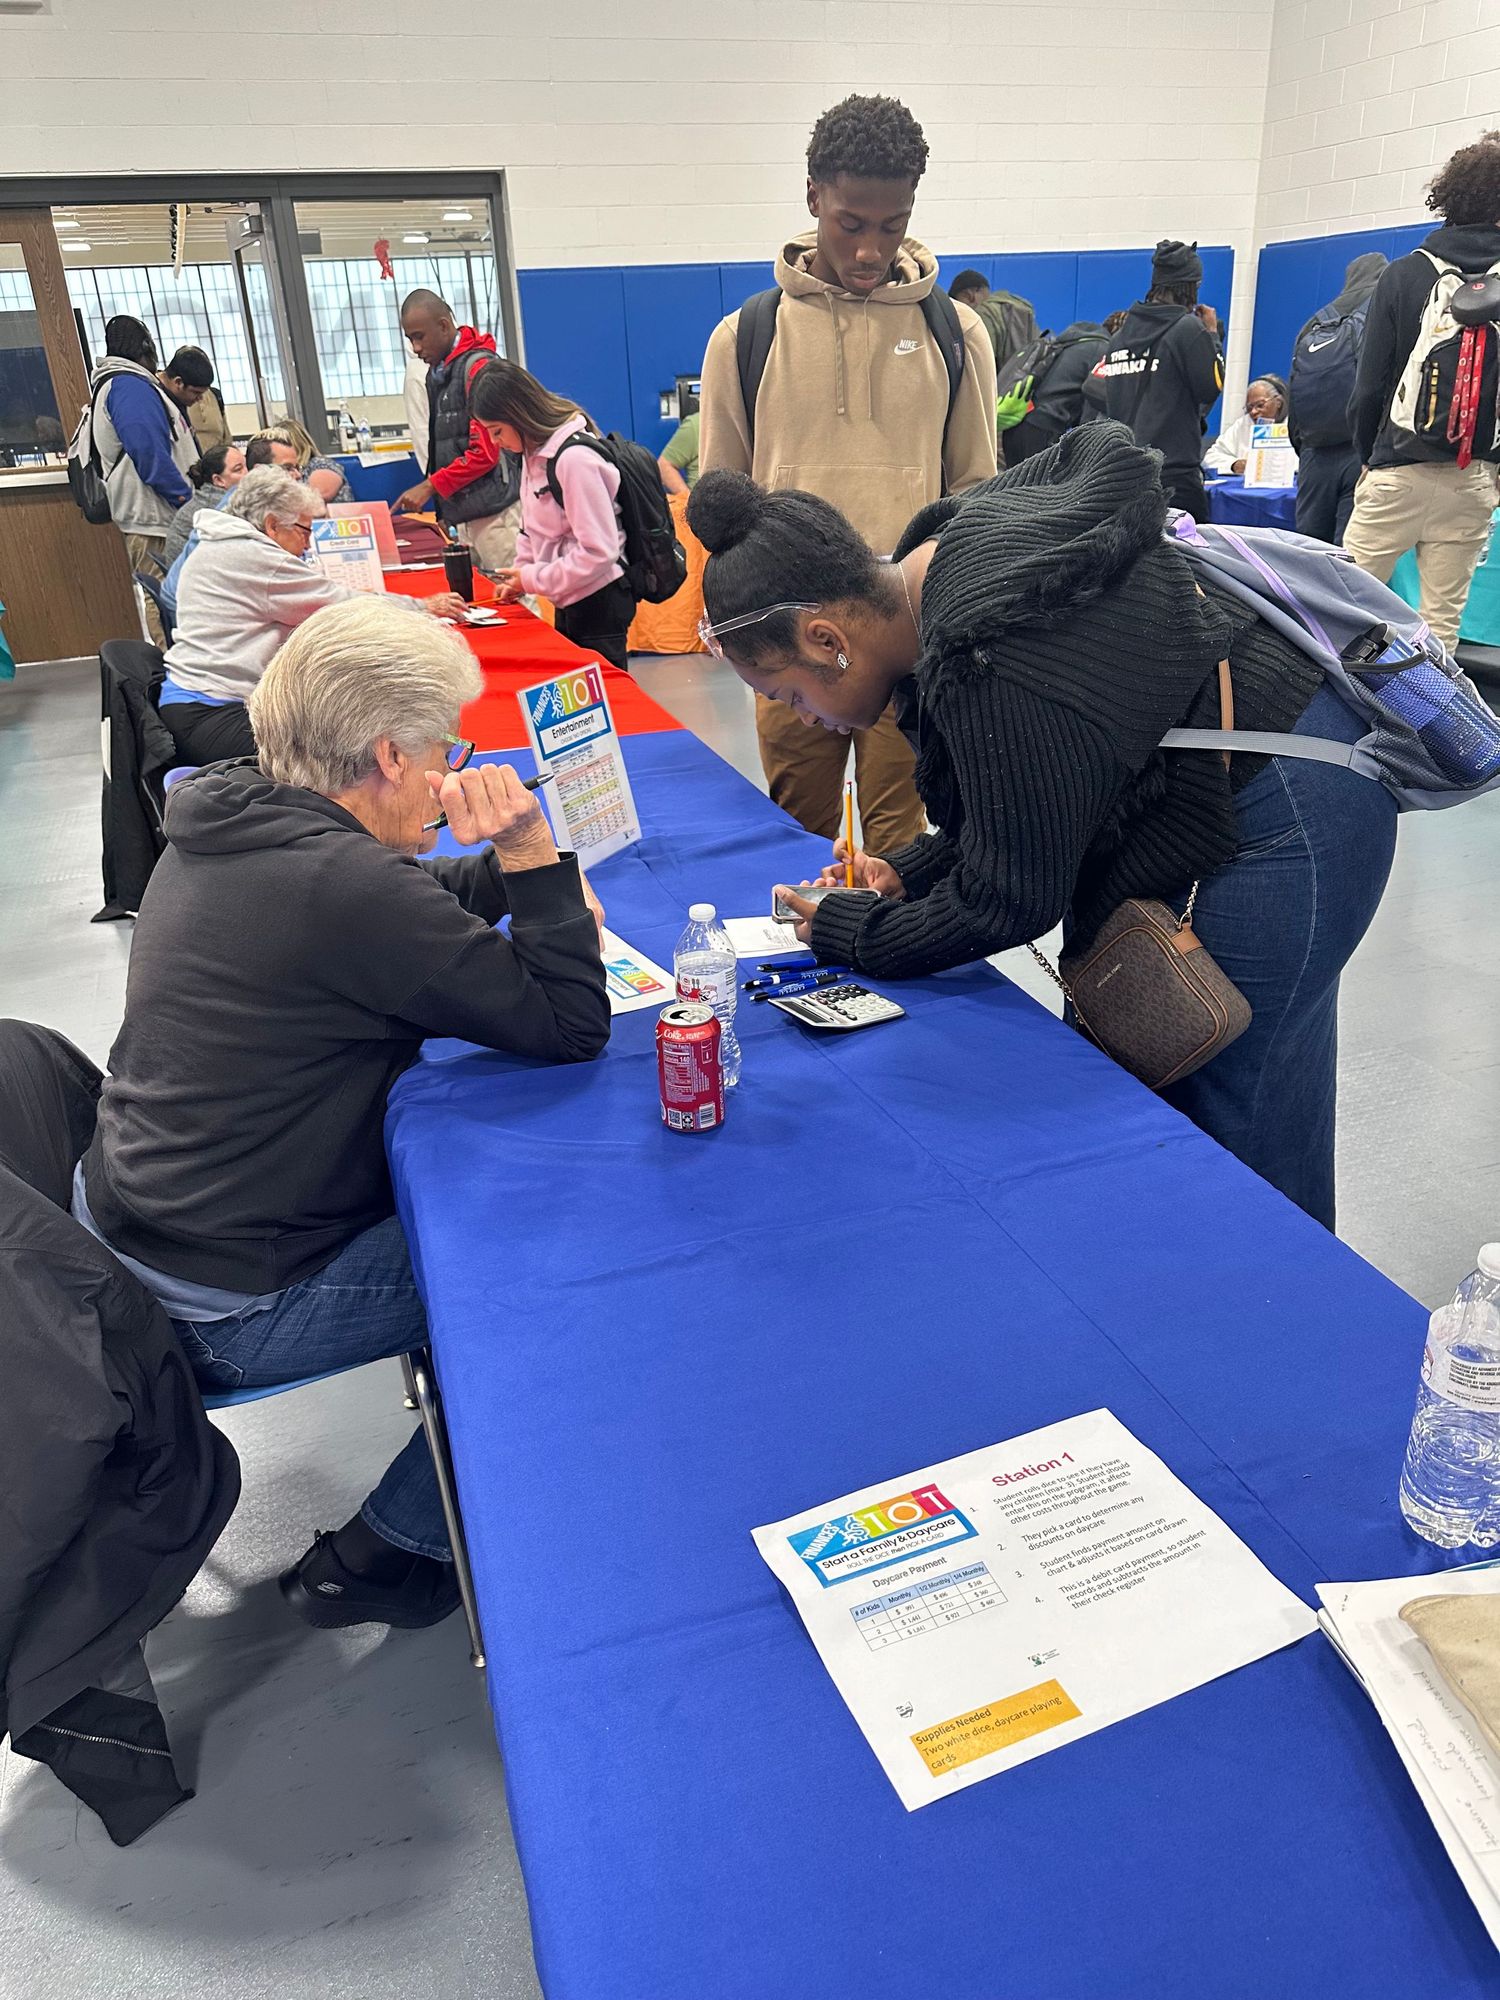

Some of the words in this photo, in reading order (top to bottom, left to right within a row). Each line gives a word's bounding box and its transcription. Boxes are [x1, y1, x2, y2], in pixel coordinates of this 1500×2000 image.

[899, 339, 918, 350] NIKE
[339, 520, 369, 536] 101
[532, 685, 551, 727] FINANCES
[551, 713, 594, 739] Entertainment
[664, 1029, 681, 1039] Coke
[992, 1459, 1062, 1486] Station
[1062, 1452, 1075, 1463] 1
[993, 1491, 1024, 1505] Student
[1024, 1486, 1040, 1494] rolls
[1041, 1480, 1056, 1488] dice
[1067, 1472, 1080, 1480] see
[1086, 1464, 1103, 1474] they
[1102, 1458, 1120, 1468] have
[1000, 1502, 1014, 1511] any
[1015, 1491, 1045, 1506] children
[1077, 1471, 1105, 1485] Student
[1106, 1462, 1130, 1474] should
[1005, 1507, 1025, 1518] enter
[1026, 1501, 1040, 1510] this
[1052, 1492, 1066, 1501] the
[1066, 1482, 1100, 1497] program,
[1107, 1471, 1131, 1482] affects
[1010, 1513, 1031, 1525] other
[1032, 1506, 1052, 1517] costs
[1051, 1491, 1094, 1511] throughout
[1094, 1487, 1107, 1496] the
[801, 1522, 839, 1560] FINANCES
[997, 1543, 1007, 1551] 2.
[1021, 1532, 1042, 1543] They
[1042, 1526, 1058, 1536] pick
[1065, 1517, 1082, 1527] card
[1092, 1500, 1130, 1517] determine
[1131, 1496, 1144, 1504] any
[1028, 1534, 1064, 1551] discounts
[1065, 1530, 1076, 1538] on
[1076, 1519, 1106, 1534] daycare
[822, 1551, 849, 1569] Start
[850, 1550, 859, 1559] a
[859, 1537, 898, 1557] Family
[898, 1534, 907, 1542] &
[907, 1518, 955, 1540] Daycare
[847, 1560, 863, 1569] ROLL
[875, 1550, 890, 1559] DICE
[890, 1545, 906, 1555] then
[906, 1540, 920, 1549] PICK
[926, 1532, 944, 1542] CARD
[1015, 1570, 1024, 1578] 3.
[1040, 1553, 1072, 1569] Student
[1072, 1546, 1091, 1557] finds
[1092, 1533, 1125, 1550] payment
[1126, 1522, 1155, 1537] amount
[1047, 1565, 1068, 1576] chart
[1076, 1551, 1105, 1566] adjusts
[1110, 1539, 1135, 1552] based
[1135, 1535, 1146, 1543] on
[1146, 1527, 1163, 1539] card
[1163, 1518, 1188, 1532] drawn
[1059, 1582, 1078, 1594] This
[1077, 1580, 1086, 1588] is
[1092, 1569, 1113, 1582] debit
[1113, 1561, 1131, 1573] card
[1131, 1549, 1168, 1567] payment,
[1177, 1530, 1207, 1547] student
[872, 1571, 908, 1588] Daycare
[908, 1555, 947, 1575] Payment
[927, 1577, 951, 1590] Monthly
[962, 1565, 985, 1578] Monthly
[1066, 1586, 1096, 1602] records
[1097, 1578, 1112, 1590] and
[1112, 1565, 1148, 1584] subtracts
[1148, 1560, 1162, 1570] the
[1164, 1546, 1193, 1563] amount
[860, 1606, 866, 1614] of
[866, 1602, 881, 1612] Kids
[888, 1591, 912, 1604] Monthly
[1072, 1597, 1092, 1609] their
[1093, 1588, 1116, 1600] check
[1116, 1576, 1146, 1590] register
[916, 1723, 956, 1745] Supplies
[955, 1708, 992, 1728] Needed
[922, 1742, 944, 1757] Two
[944, 1731, 971, 1748] white
[972, 1722, 995, 1737] dice,
[994, 1709, 1029, 1729] daycare
[1030, 1696, 1062, 1714] playing
[931, 1753, 957, 1770] cards
